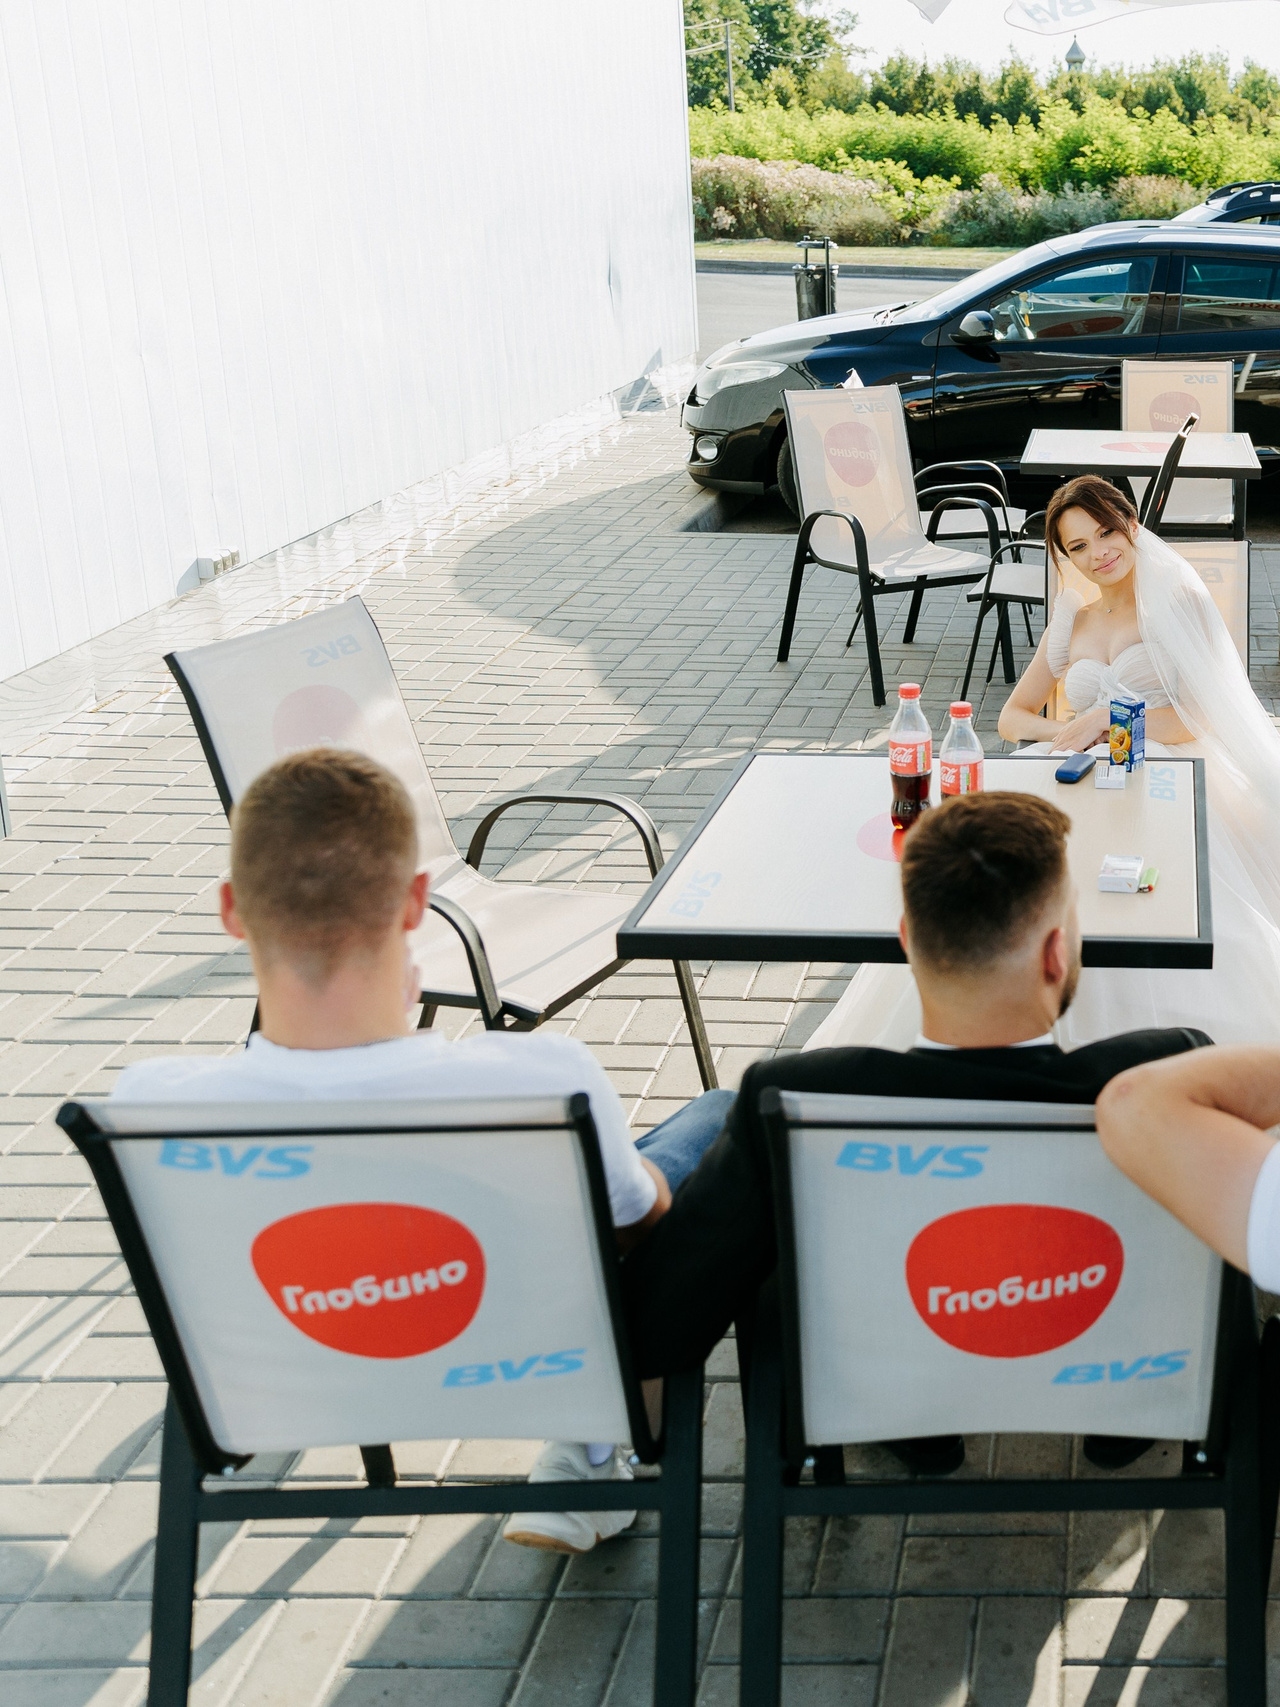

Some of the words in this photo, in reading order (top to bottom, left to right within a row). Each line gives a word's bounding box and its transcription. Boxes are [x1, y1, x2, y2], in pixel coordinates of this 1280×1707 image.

[889, 746, 916, 763] Cola
[1149, 764, 1177, 802] BVS
[668, 869, 724, 918] BVS
[157, 1138, 316, 1180] BVS
[835, 1141, 991, 1181] BVS
[280, 1258, 470, 1315] Глобино
[927, 1263, 1107, 1315] Глобино
[441, 1347, 588, 1389] BVS
[1051, 1349, 1192, 1386] BVS
